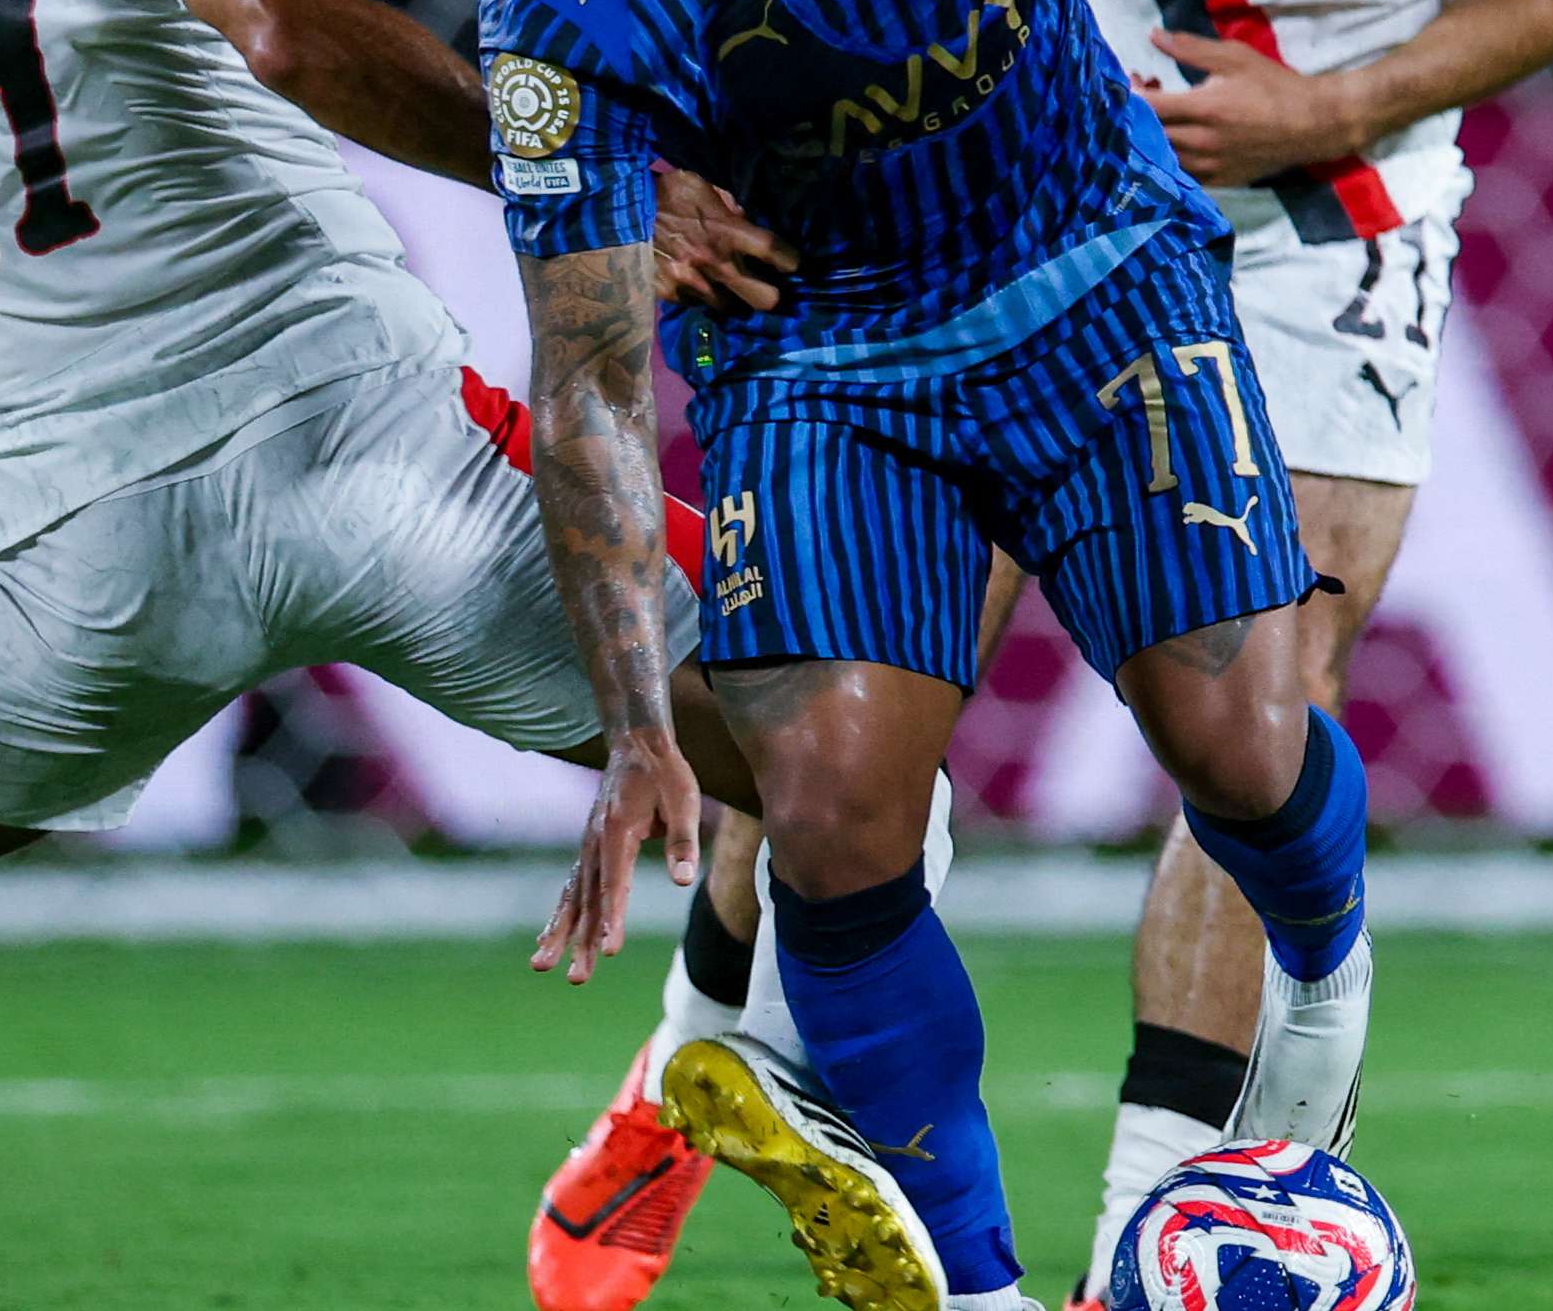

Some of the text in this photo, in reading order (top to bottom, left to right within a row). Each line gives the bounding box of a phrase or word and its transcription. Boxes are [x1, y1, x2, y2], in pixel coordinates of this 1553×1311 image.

[493, 58, 534, 85] WORLD
[535, 62, 563, 86] CUP
[922, 24, 1031, 132] GROUP
[556, 87, 571, 107] 25
[546, 109, 571, 136] USA
[506, 128, 544, 150] FIFA
[1095, 339, 1261, 493] 77
